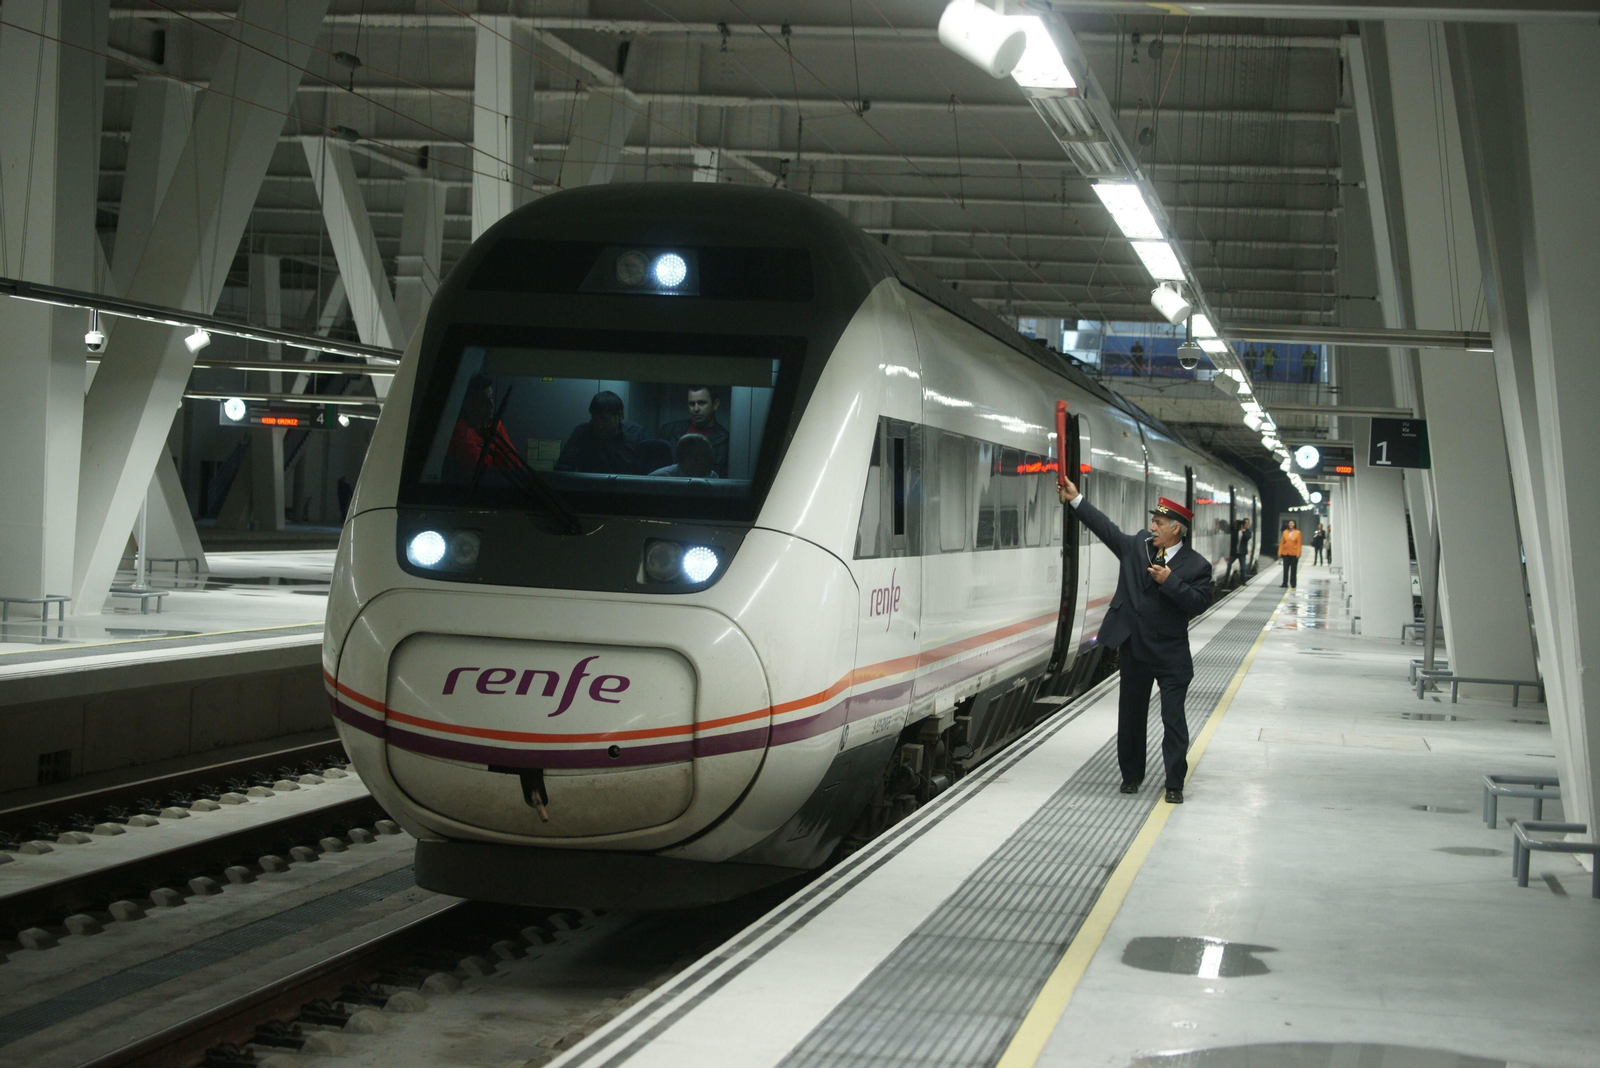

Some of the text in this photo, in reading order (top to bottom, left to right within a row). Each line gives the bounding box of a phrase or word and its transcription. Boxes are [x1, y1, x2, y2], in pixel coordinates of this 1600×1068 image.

[262, 417, 276, 425] VIGO
[316, 412, 324, 424] 4
[1376, 441, 1392, 465] 1
[870, 567, 901, 633] renfe
[442, 656, 631, 718] renfe
